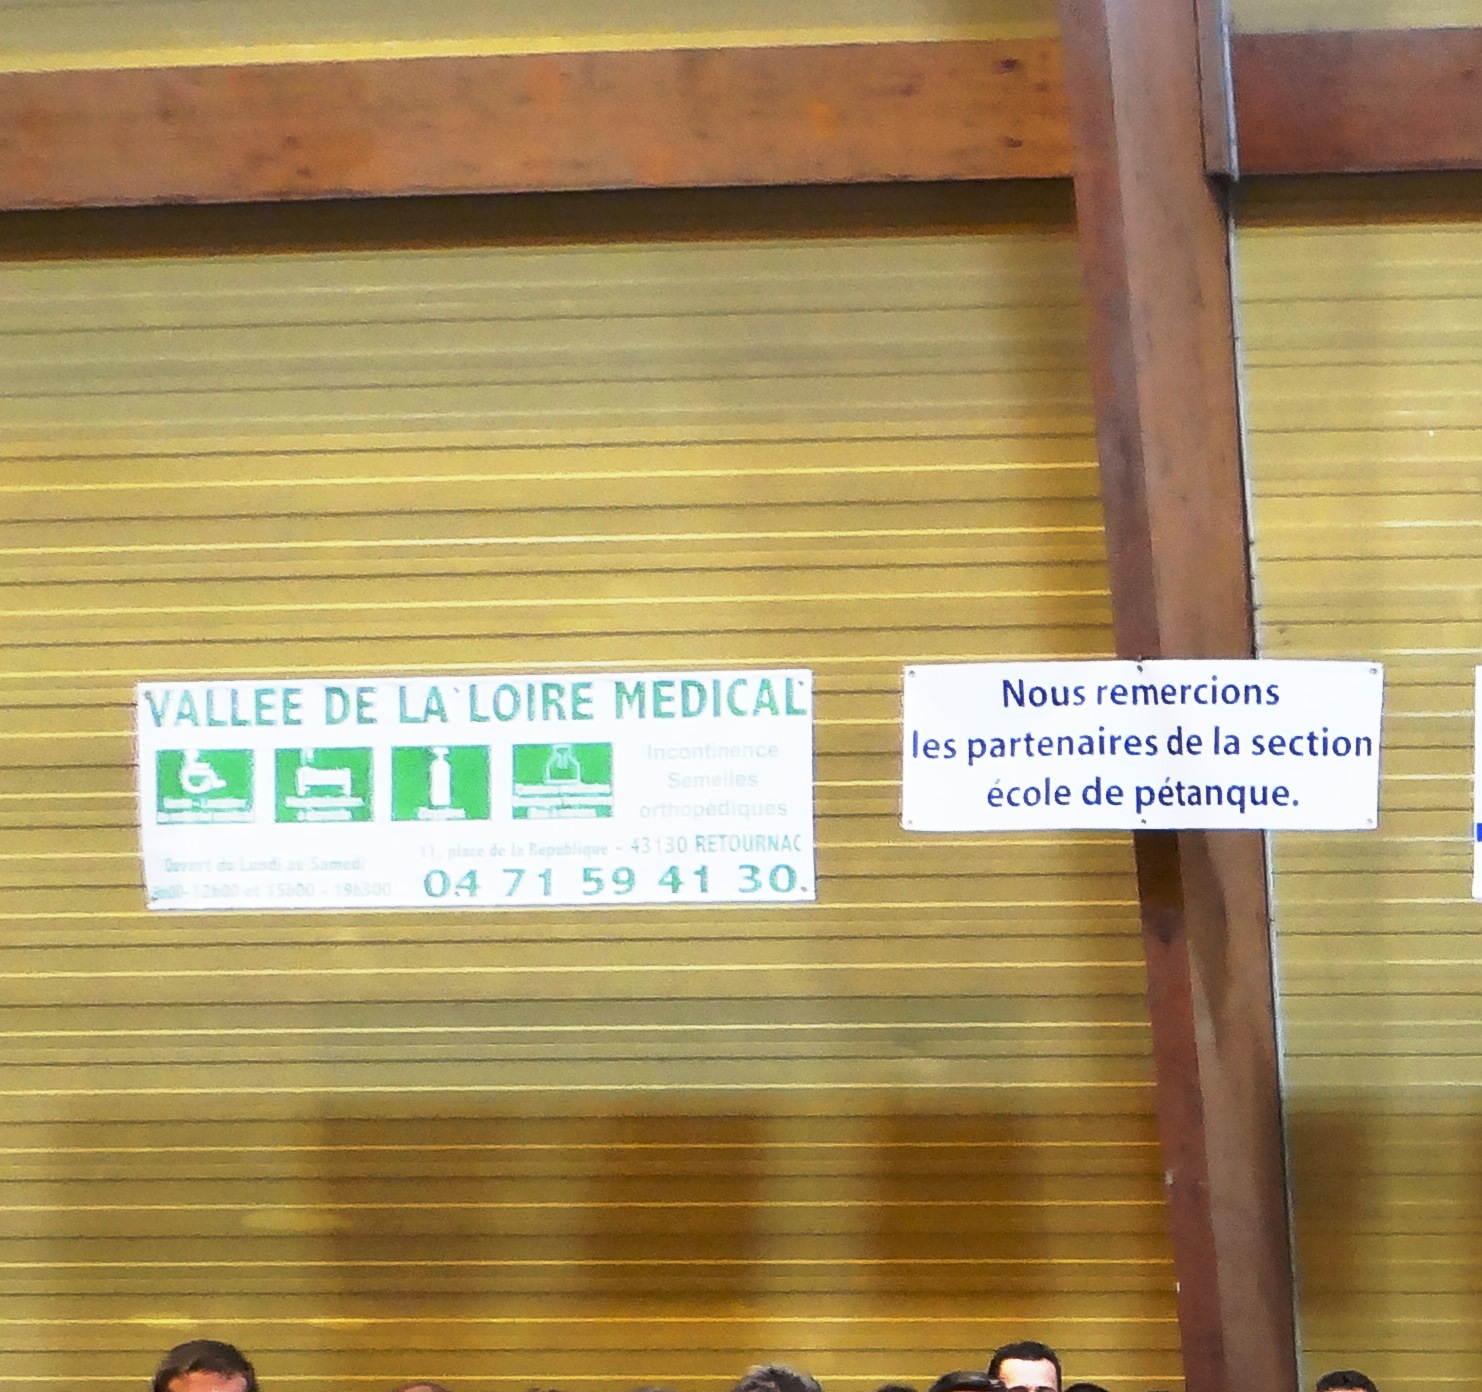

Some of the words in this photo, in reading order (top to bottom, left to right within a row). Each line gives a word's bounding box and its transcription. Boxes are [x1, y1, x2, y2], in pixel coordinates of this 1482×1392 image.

[144, 687, 303, 728] VALLEE
[325, 686, 378, 726] DE
[399, 685, 448, 724] LA
[469, 681, 594, 723] LOIRE
[615, 677, 808, 720] MEDICAL
[1001, 678, 1086, 708] Nous
[1096, 674, 1281, 706] remercions
[647, 743, 779, 761] Incontinence
[911, 729, 957, 759] les
[966, 725, 1158, 765] partenaires
[1167, 725, 1203, 757] de
[1212, 725, 1240, 757] la
[1251, 726, 1373, 757] section
[668, 770, 759, 789] Semelles
[986, 777, 1071, 807] école
[1081, 776, 1124, 806] de
[1134, 776, 1299, 814] pétanque.
[489, 843, 506, 857] de
[511, 843, 524, 857] la
[630, 835, 688, 854] 43130
[695, 834, 802, 854] RETOURNAC
[423, 868, 481, 898] 04
[502, 867, 552, 897] 71
[580, 866, 636, 896] 59
[658, 864, 709, 894] 41
[738, 863, 799, 893] 30
